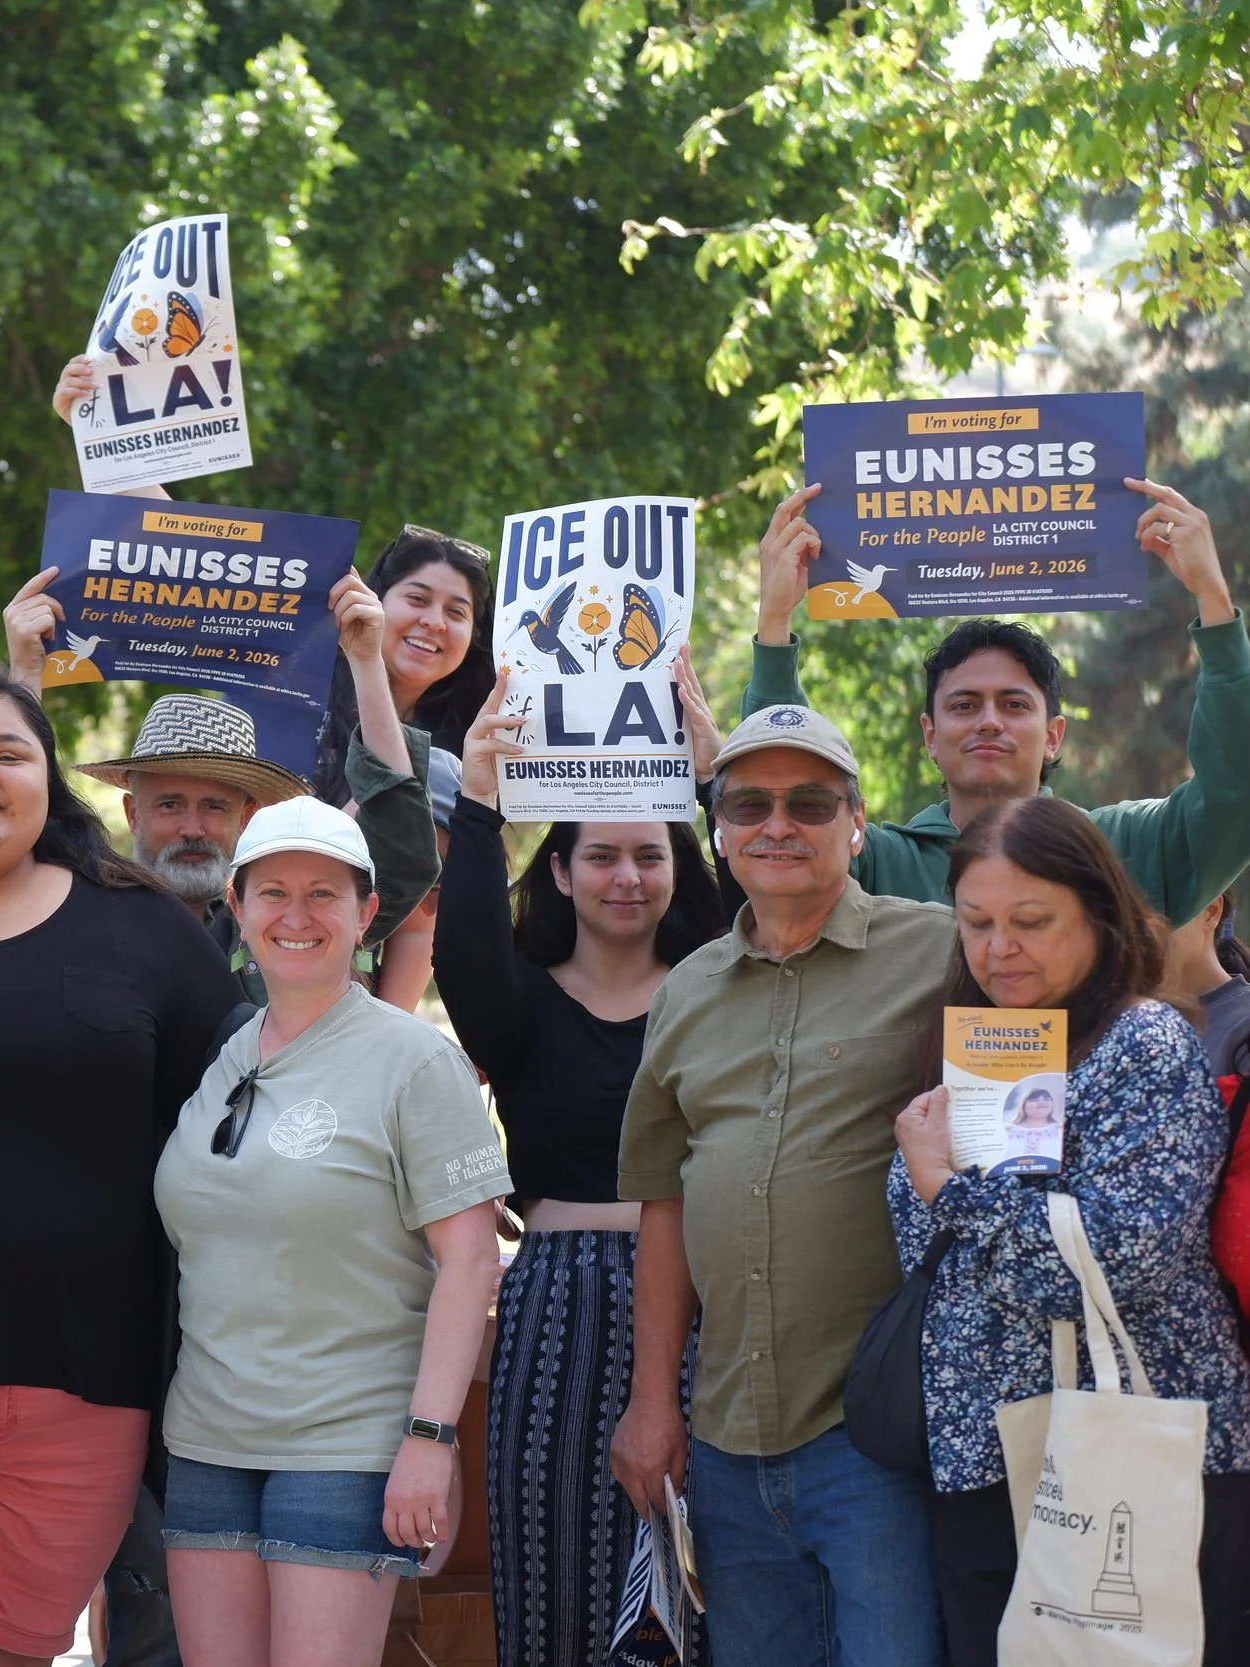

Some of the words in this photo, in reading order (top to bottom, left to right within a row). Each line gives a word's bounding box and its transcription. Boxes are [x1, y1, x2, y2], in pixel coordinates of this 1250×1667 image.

[153, 221, 222, 299] OUT
[107, 359, 233, 427] LA!
[78, 389, 100, 427] of
[951, 413, 997, 431] voting
[999, 413, 1023, 430] for
[84, 433, 152, 461] EUNISSES
[154, 416, 241, 447] HERNANDEZ
[124, 453, 134, 462] Los
[133, 450, 155, 461] Angeles
[155, 447, 167, 458] City
[190, 439, 213, 449] District
[208, 452, 241, 464] EUNISSES
[855, 441, 1097, 485] EUNISSES
[856, 483, 1097, 520] HERNANDEZ
[183, 520, 225, 538] voting
[227, 523, 248, 538] for
[859, 529, 890, 547] For
[893, 528, 921, 546] the
[926, 525, 986, 548] People
[993, 523, 1008, 534] LA
[1010, 521, 1039, 533] CITY
[1040, 519, 1097, 532] COUNCIL
[993, 534, 1048, 547] DISTRICT
[1051, 534, 1059, 544] 1
[87, 539, 310, 589] EUNISSES
[503, 510, 586, 608] ICE
[603, 504, 689, 599] OUT
[917, 562, 986, 580] Tuesday,
[988, 561, 1025, 578] June
[1029, 560, 1044, 577] 2,
[1047, 558, 1087, 574] 2026
[83, 577, 302, 615] HERNANDEZ
[80, 607, 109, 623] For
[112, 610, 138, 625] the
[141, 612, 196, 630] People
[202, 615, 216, 625] LA
[219, 616, 244, 628] CITY
[246, 618, 296, 632] COUNCIL
[200, 624, 252, 638] DISTRICT
[253, 629, 259, 638] 1
[128, 639, 189, 657] Tuesday,
[191, 643, 224, 659] June
[227, 647, 240, 662] 2,
[244, 650, 280, 667] 2026
[543, 681, 686, 747] LA!
[505, 760, 587, 780] EUNISSES
[589, 759, 690, 779] HERNANDEZ
[539, 780, 549, 788] for
[550, 780, 562, 788] Los
[562, 780, 589, 789] Angeles
[589, 780, 603, 789] City
[604, 780, 633, 789] Council,
[633, 779, 660, 788] District
[652, 803, 687, 811] EUNISSES
[973, 1026, 1040, 1038] EUNISSES
[964, 1040, 1049, 1051] HERNANDEZ
[445, 1158, 462, 1174] NO
[447, 1172, 460, 1187] IS
